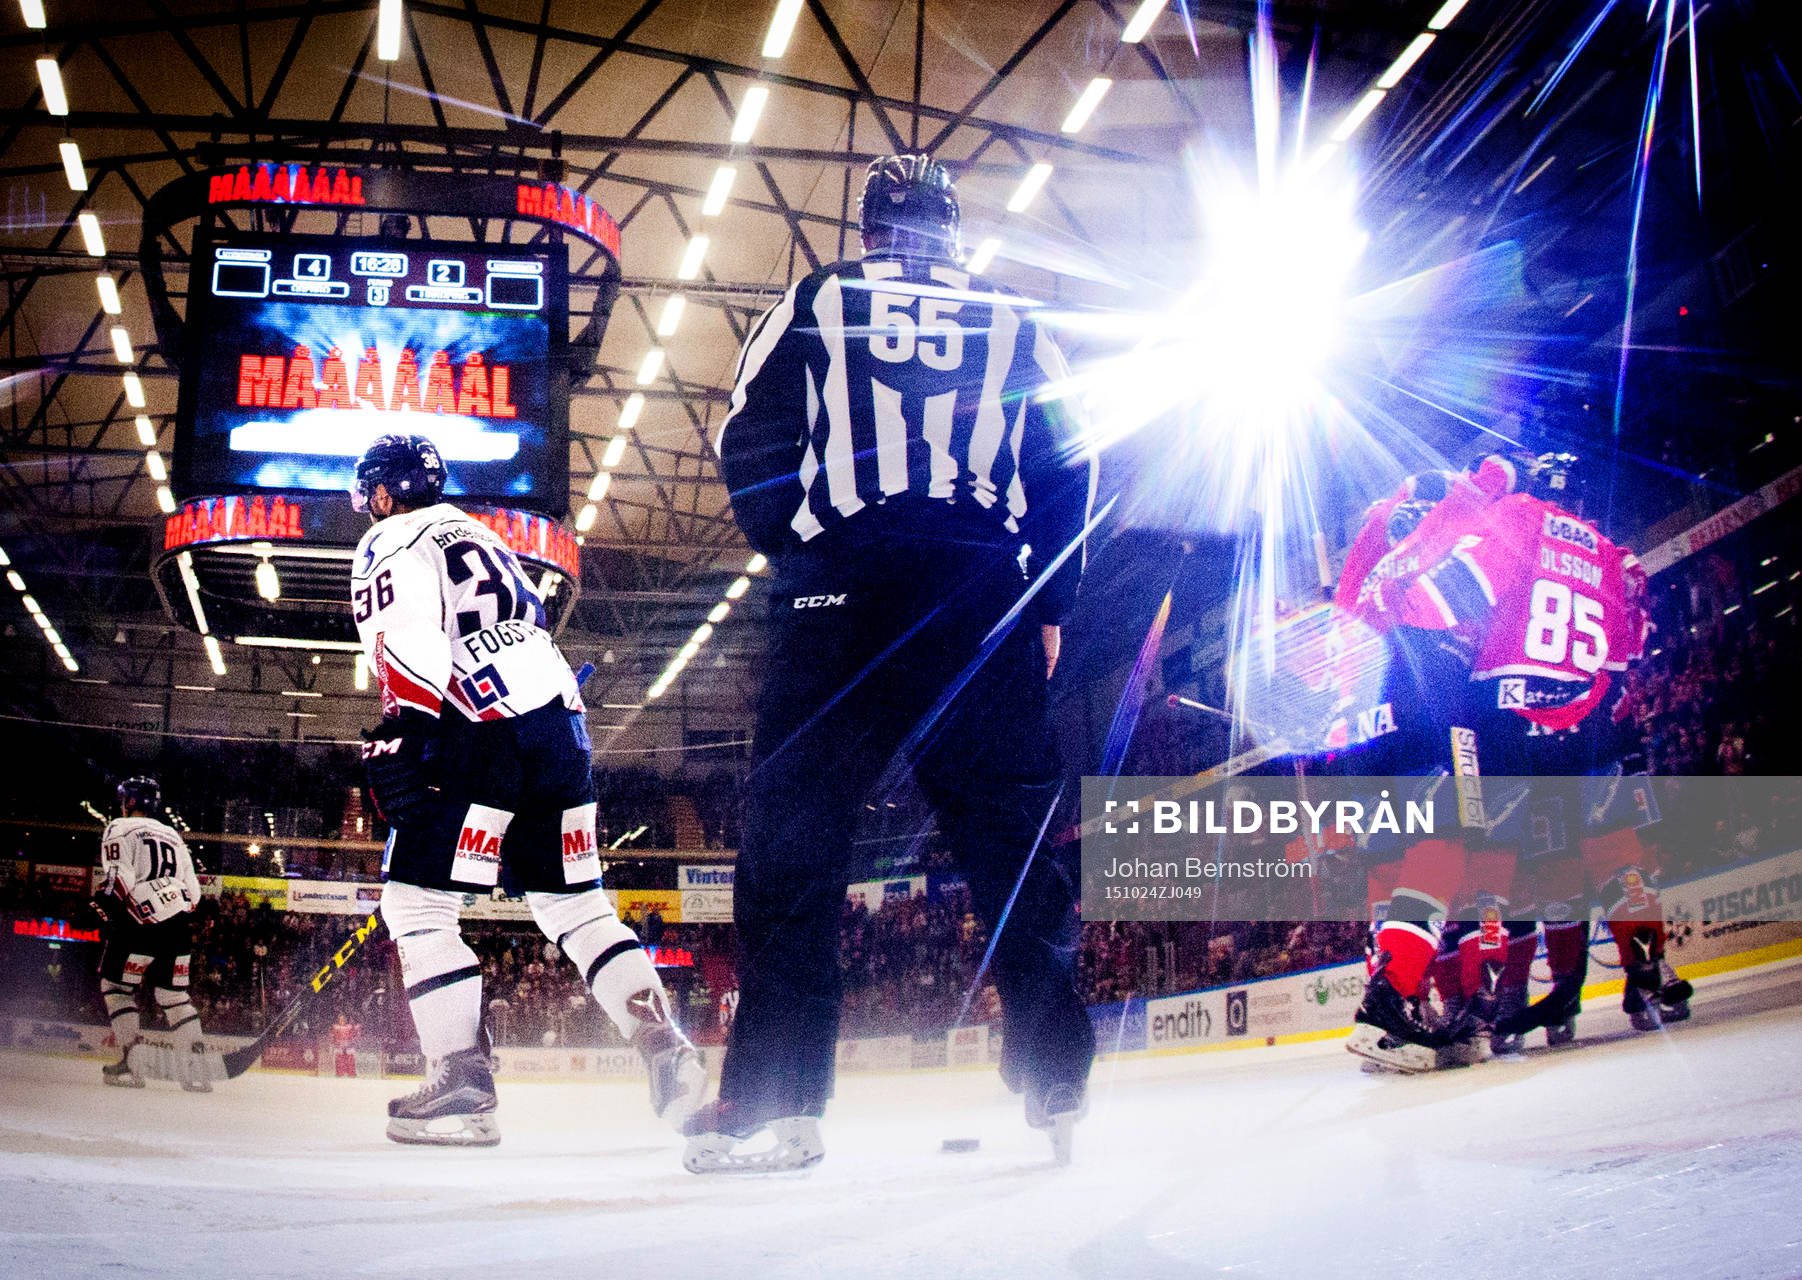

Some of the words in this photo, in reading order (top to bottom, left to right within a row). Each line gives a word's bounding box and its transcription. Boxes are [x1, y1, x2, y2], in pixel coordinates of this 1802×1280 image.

[307, 259, 321, 276] 4
[436, 265, 450, 282] 2
[869, 291, 963, 371] 55
[237, 345, 517, 418] MÅÅÅÅÅÅL
[354, 569, 394, 623] 36
[793, 593, 848, 609] CCM
[1525, 579, 1609, 673] 85
[104, 843, 119, 860] 18
[310, 914, 378, 993] CCM
